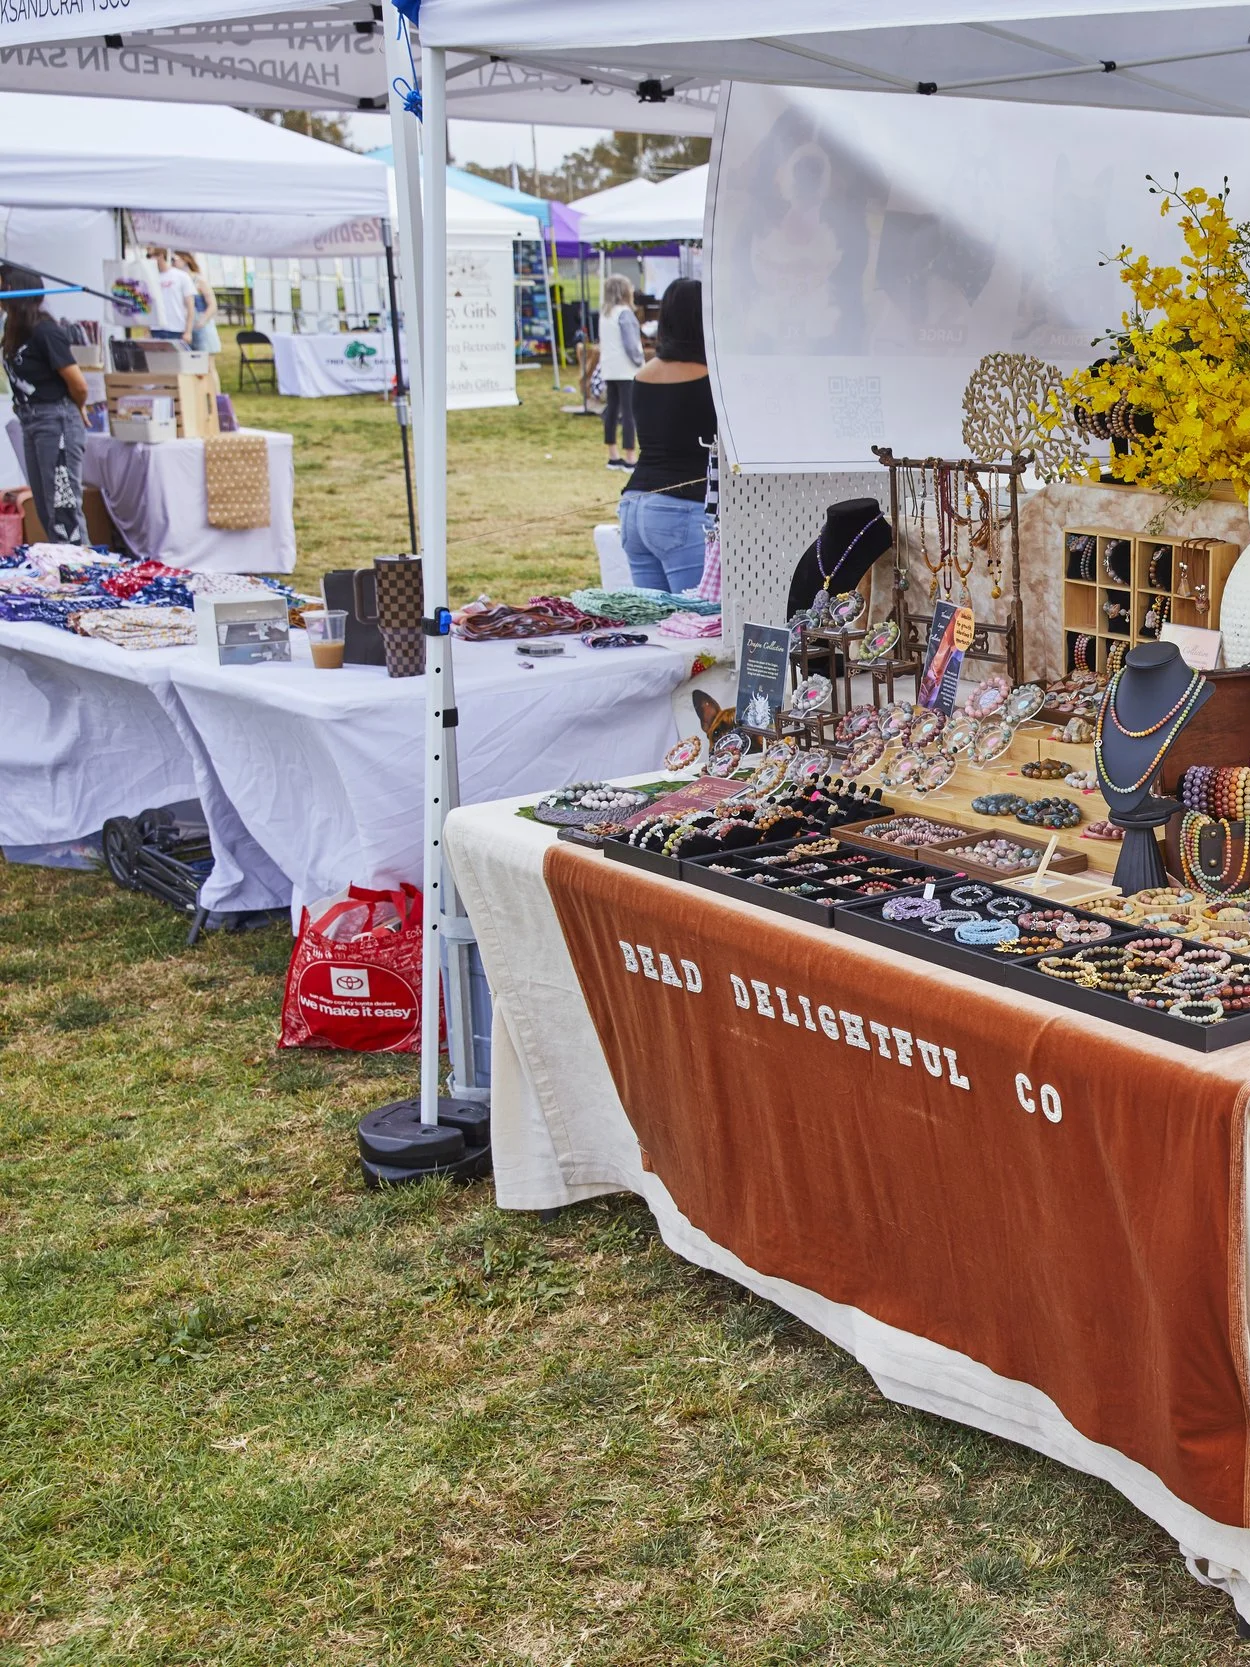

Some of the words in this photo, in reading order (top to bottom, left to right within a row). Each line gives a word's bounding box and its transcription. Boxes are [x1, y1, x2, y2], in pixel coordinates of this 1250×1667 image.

[463, 301, 497, 318] Girls
[746, 638, 762, 654] Dragon
[762, 640, 785, 653] Collection
[300, 994, 318, 1010] We
[319, 1003, 360, 1018] make
[361, 1006, 373, 1018] it
[374, 1008, 412, 1020] easy
[333, 999, 354, 1007] county
[618, 940, 704, 994] BEAD
[730, 973, 971, 1091] DELIGHTFUL
[1015, 1073, 1063, 1124] CO
